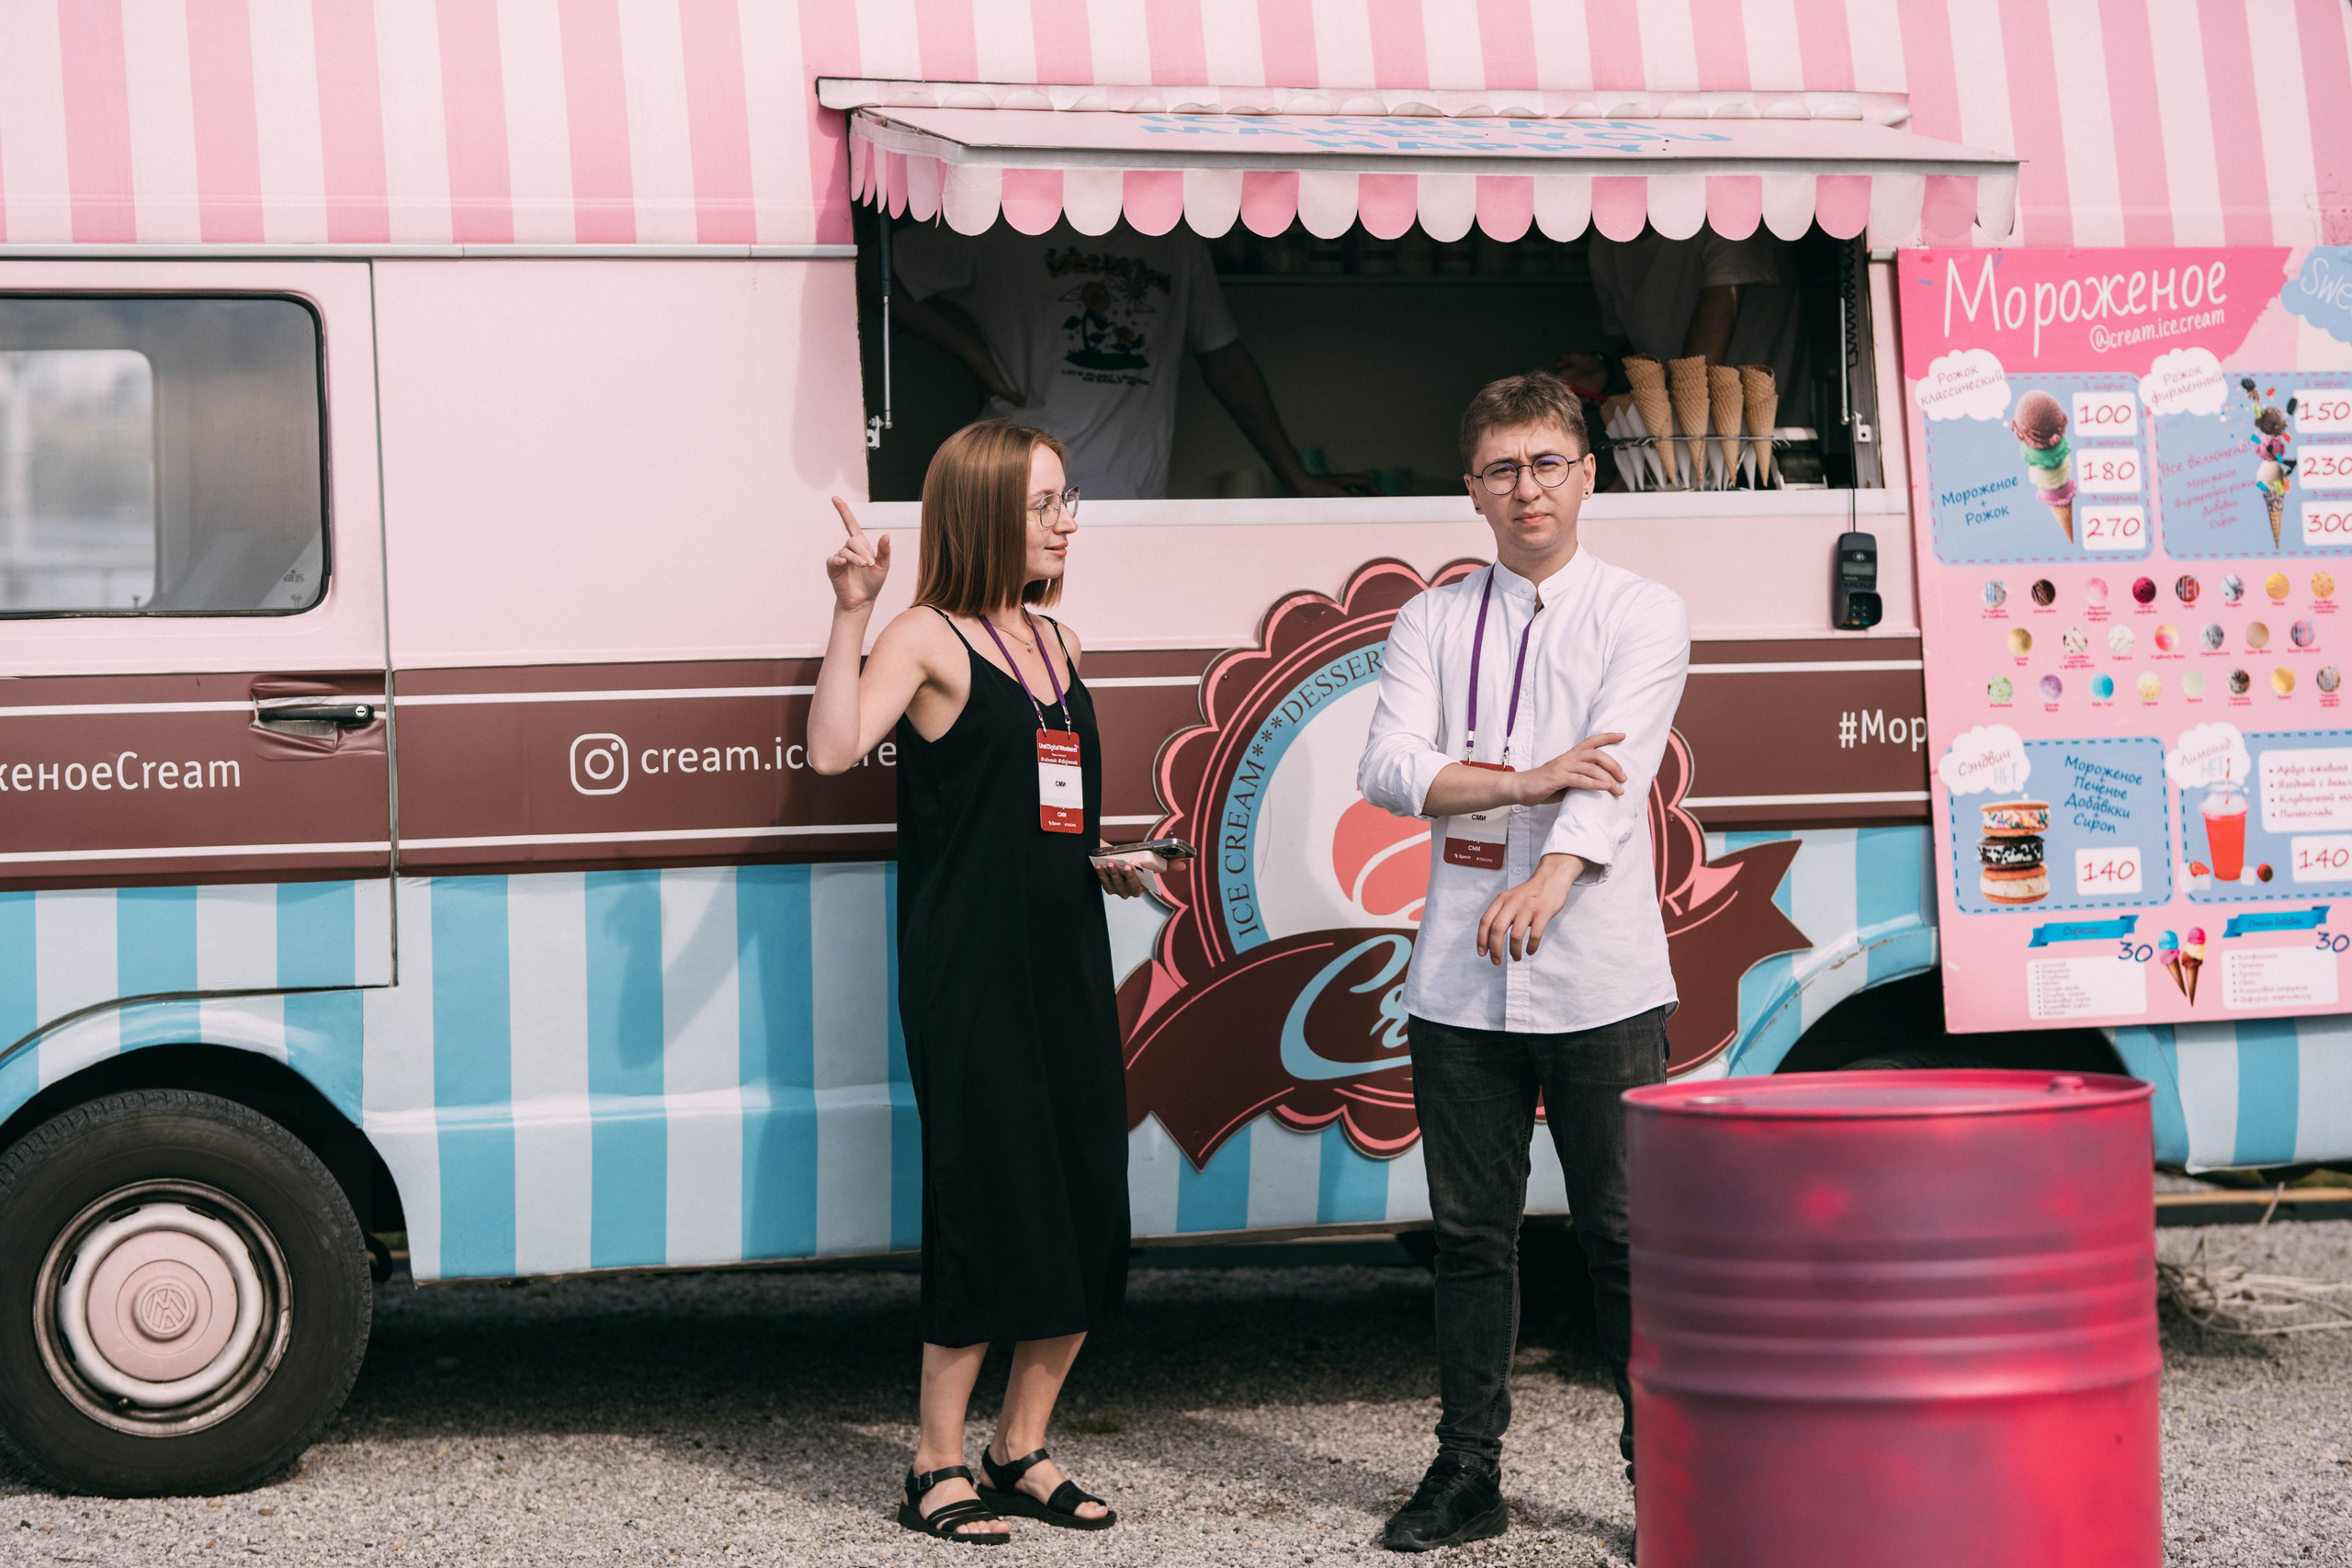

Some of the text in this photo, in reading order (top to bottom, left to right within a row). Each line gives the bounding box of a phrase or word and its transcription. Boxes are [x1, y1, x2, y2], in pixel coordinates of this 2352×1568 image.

[1135, 115, 1658, 130] ICE CREAM
[1139, 125, 1735, 141] MAKES YOU
[1303, 139, 1647, 152] HAPPY
[2300, 256, 2352, 312] Swe
[1943, 254, 2227, 358] Мороженое
[2088, 309, 2225, 354] @cream.ice.cream
[1937, 365, 1979, 386] Рожок
[2163, 366, 2203, 386] Рожок
[1920, 369, 2004, 405] классический
[2152, 371, 2223, 407] фирменный
[2078, 404, 2132, 424] 100
[2300, 401, 2351, 422] 150
[2083, 460, 2136, 481] 180
[2161, 461, 2183, 477] Все
[2302, 457, 2352, 478] 230
[1941, 475, 2019, 506] Мороженое
[1964, 504, 2010, 525] Рожок
[2308, 513, 2352, 533] 300
[2086, 517, 2141, 538] 270
[1279, 647, 1389, 726] DESSER
[1838, 708, 1927, 752] #Мор
[641, 736, 897, 774] cream.ice
[1958, 749, 2011, 777] Сэндвич
[2180, 737, 2233, 767] Лимонад
[2064, 754, 2143, 786] Мороженое
[2073, 775, 2128, 801] Печенье
[1224, 759, 1266, 874] CREAM
[2073, 812, 2117, 834] Сироп
[2299, 848, 2349, 870] 140
[2082, 860, 2136, 883] 140
[1227, 882, 1261, 939] ICE
[2118, 941, 2154, 963] 30
[2315, 931, 2350, 953] 30
